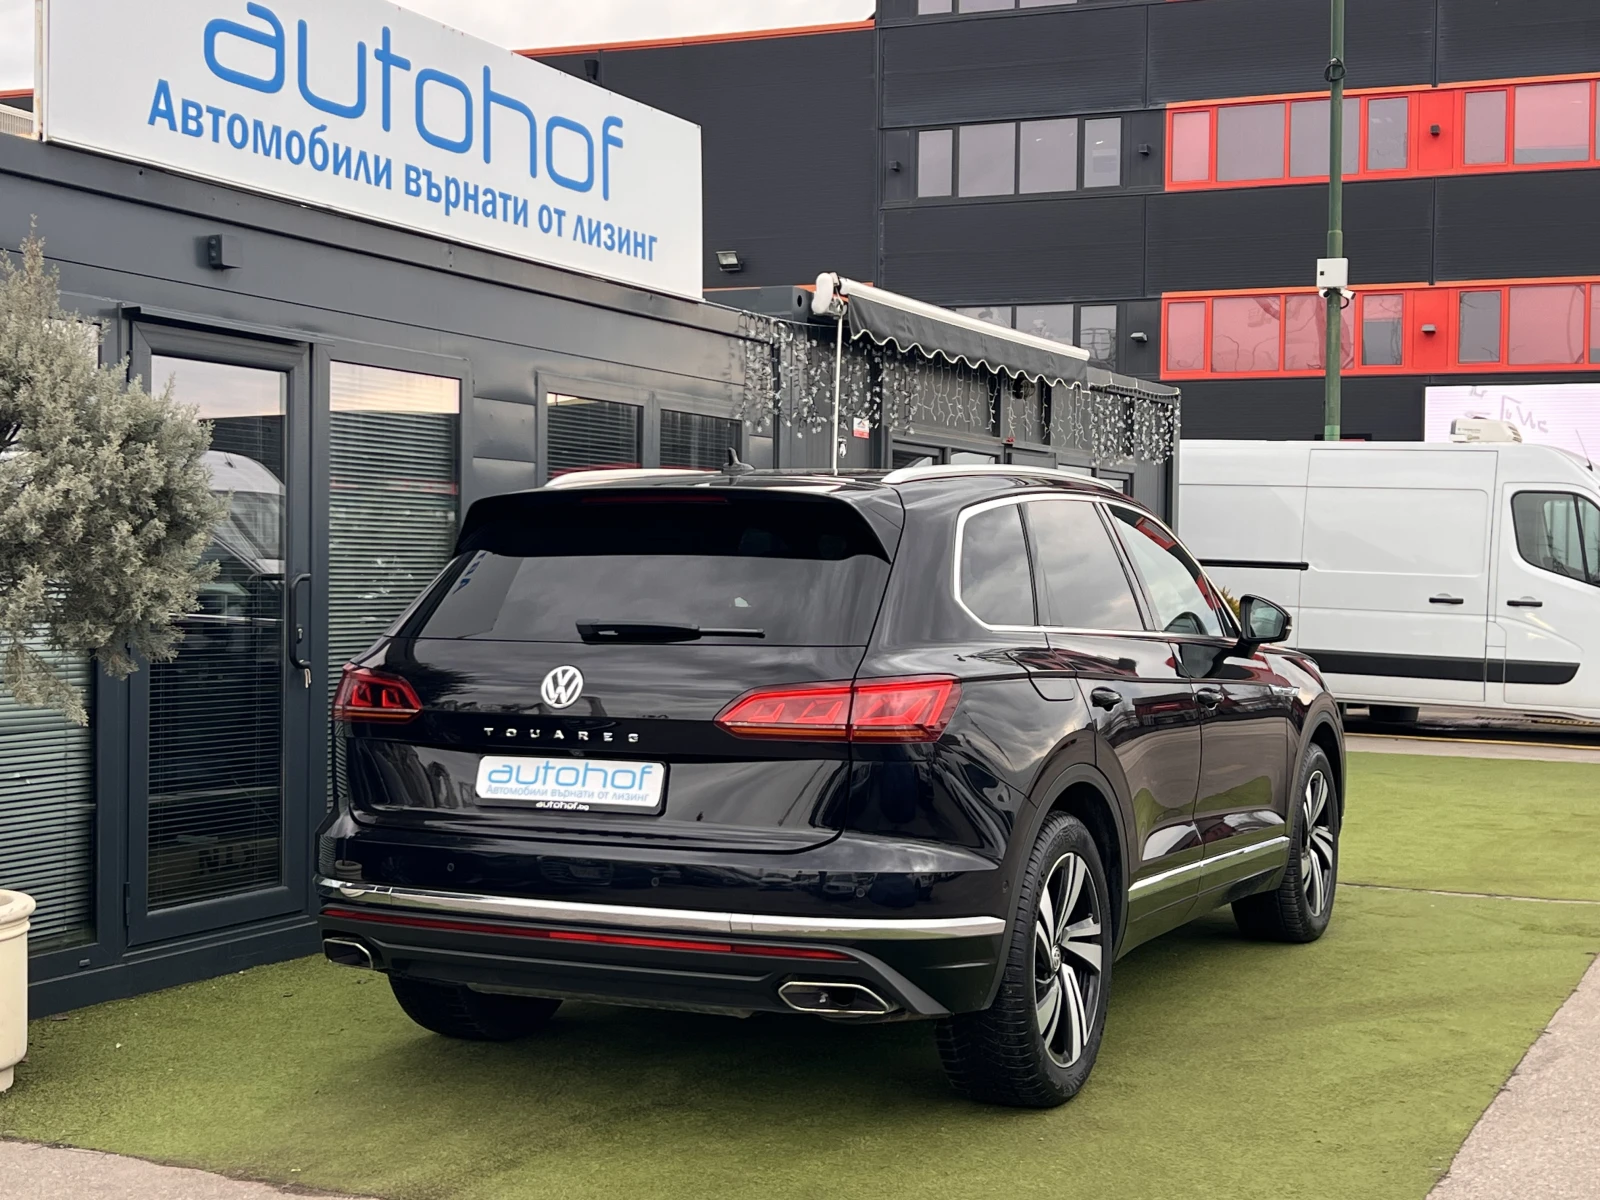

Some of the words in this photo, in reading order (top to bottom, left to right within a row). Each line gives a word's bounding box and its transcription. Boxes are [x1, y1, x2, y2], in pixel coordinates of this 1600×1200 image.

[203, 1, 624, 201] autohof
[147, 79, 393, 190] Автомобили
[404, 163, 529, 227] върнати
[537, 203, 566, 237] от
[573, 215, 658, 261] лизинг
[483, 727, 640, 743] TOUAREG
[487, 760, 653, 790] autohof
[485, 784, 549, 798] Автомобили
[550, 787, 596, 800] върнати
[597, 791, 610, 800] от
[611, 792, 650, 802] лизинг
[536, 801, 590, 811] autohof.bg
